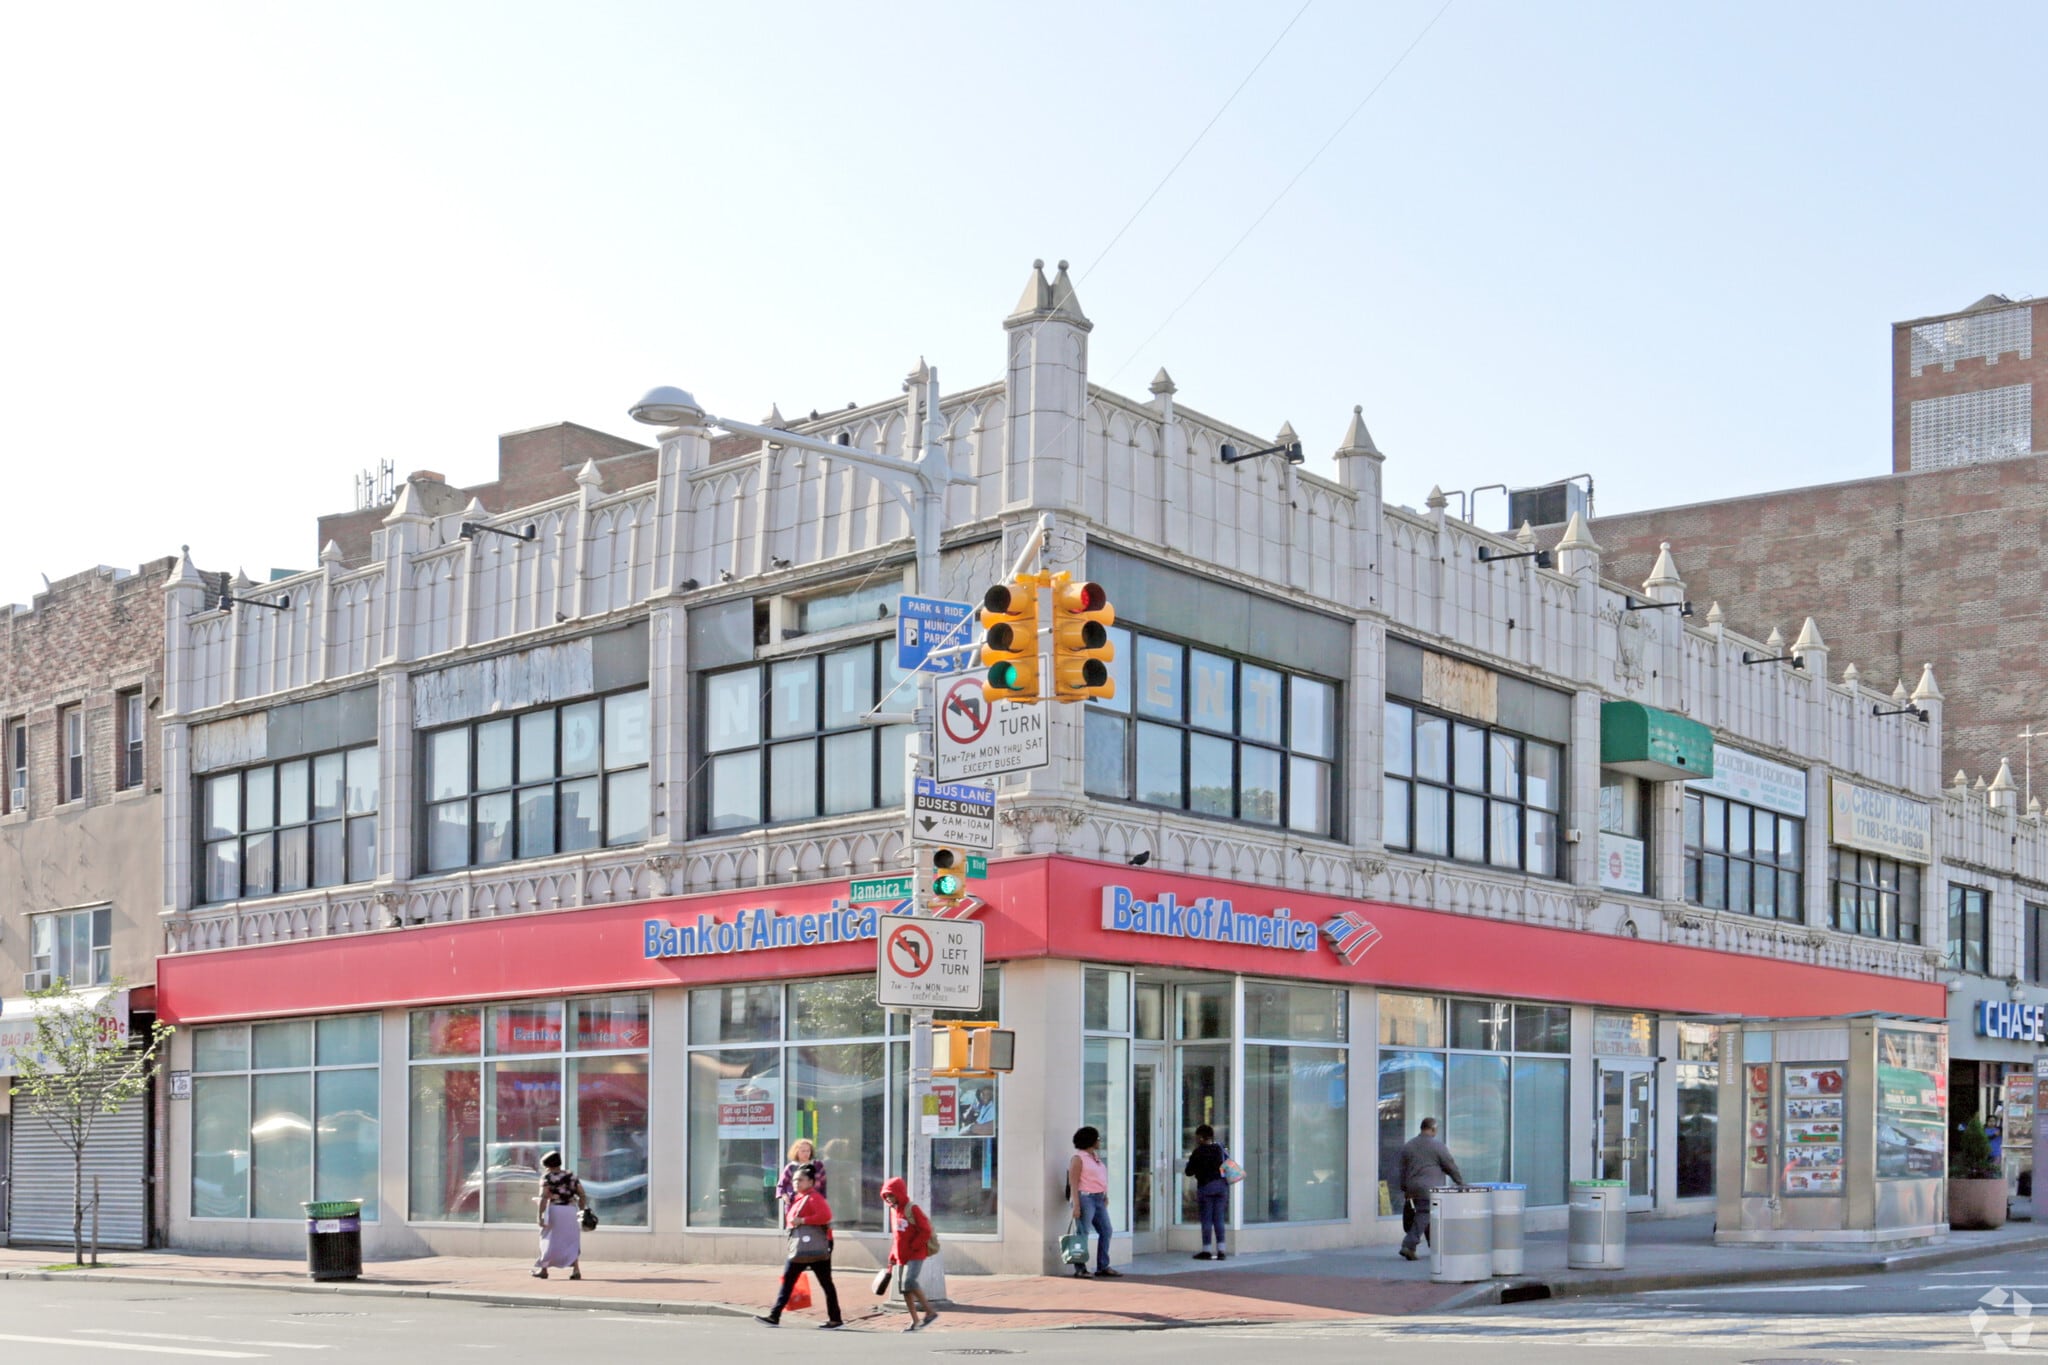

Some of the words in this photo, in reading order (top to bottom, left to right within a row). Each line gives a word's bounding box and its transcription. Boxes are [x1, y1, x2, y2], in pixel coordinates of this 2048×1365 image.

[908, 601, 931, 613] PARK
[935, 605, 941, 614] &
[944, 606, 965, 618] RIDE
[1000, 713, 1041, 737] TURN
[980, 745, 1000, 757] MON
[1003, 744, 1022, 755] THRU
[1026, 737, 1043, 751] SAT
[963, 761, 992, 774] EXCEPT
[995, 756, 1020, 769] BUSES
[934, 783, 958, 797] BUS
[961, 787, 992, 804] LANE
[918, 796, 957, 812] BUSES
[960, 802, 991, 817] ONLY
[1852, 786, 1892, 822] CREDIT
[1895, 799, 1930, 833] REPAIR
[942, 815, 991, 831] 6AM-10AM
[943, 829, 988, 844] 4PM-7PM
[853, 879, 900, 900] Jamaica
[749, 899, 877, 951] America
[1216, 899, 1318, 951] America
[948, 933, 963, 945] NO
[942, 949, 968, 960] LEFT
[940, 963, 970, 976] TURN
[925, 983, 941, 993] MON
[958, 984, 969, 994] SAT
[1985, 1000, 2045, 1042] CHASE
